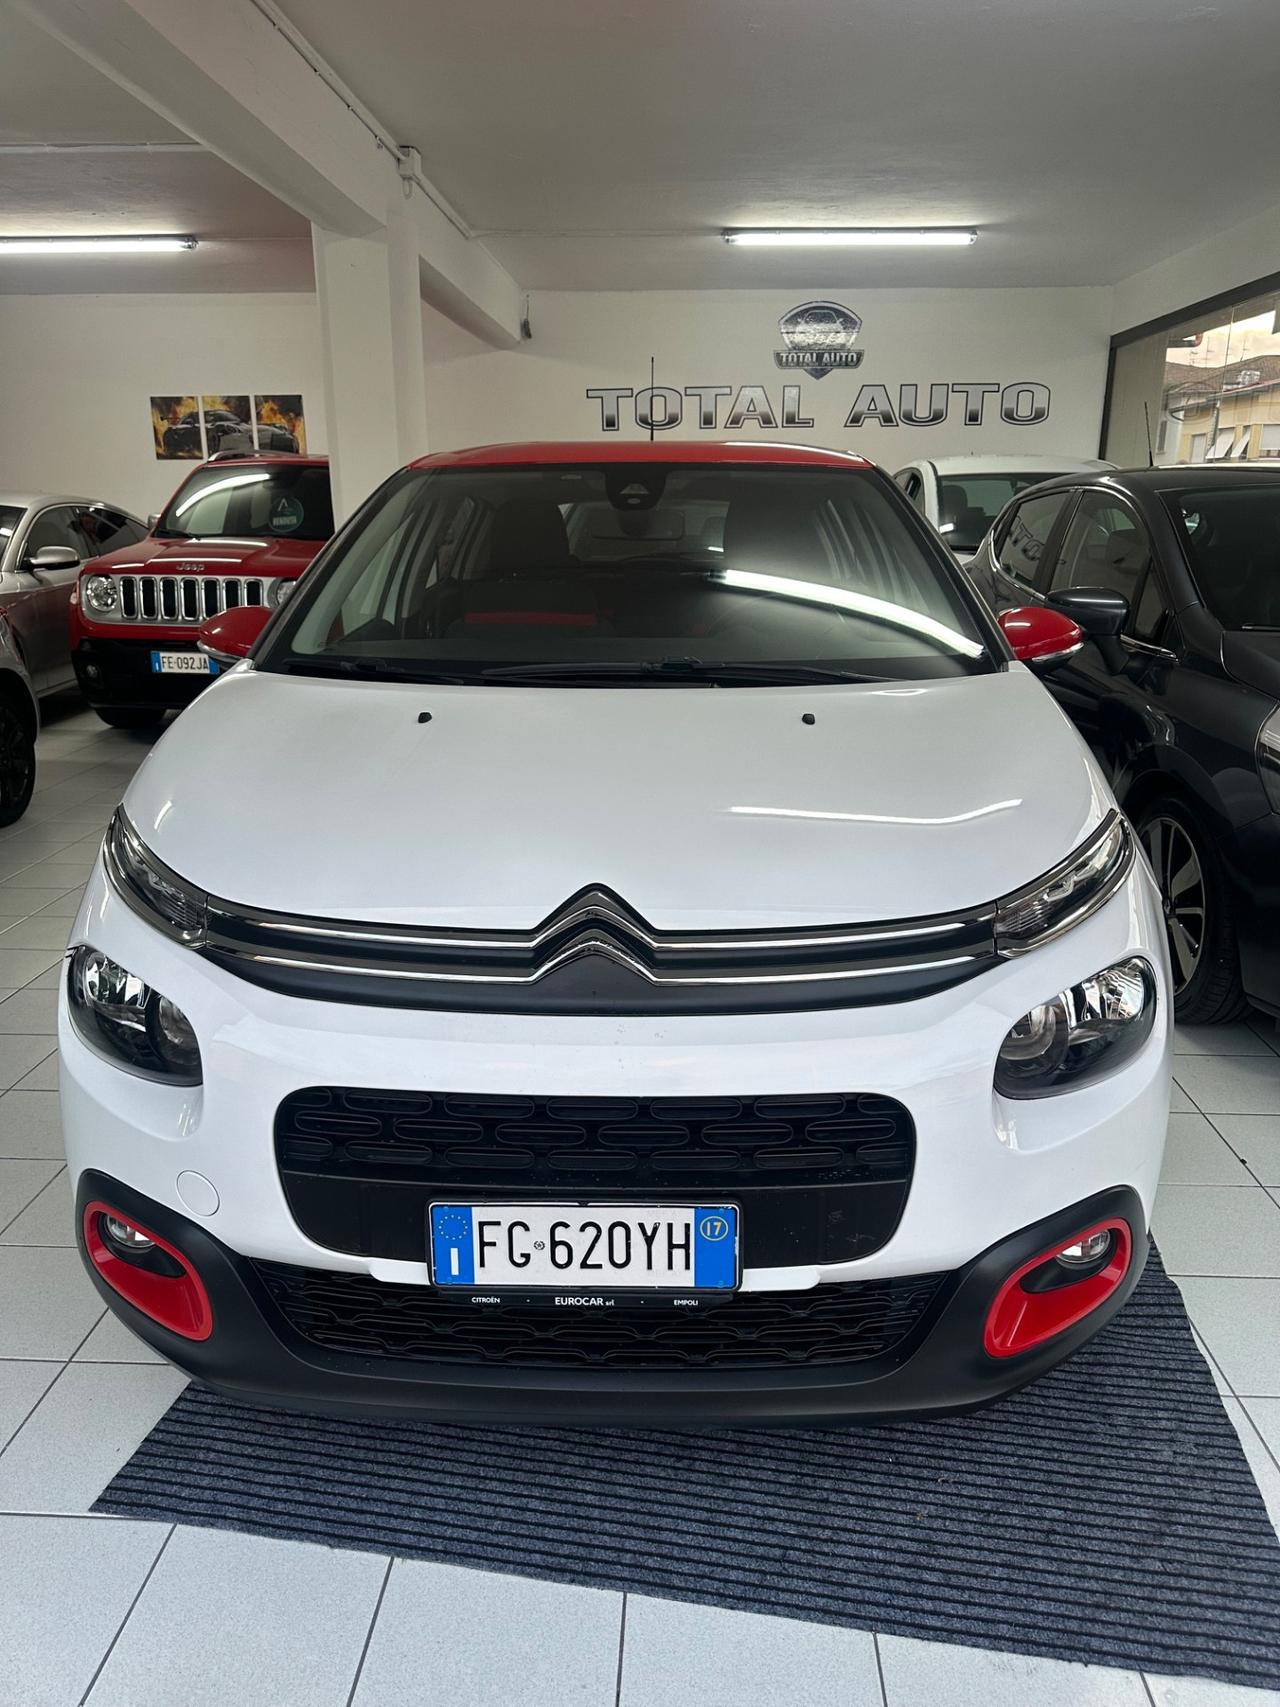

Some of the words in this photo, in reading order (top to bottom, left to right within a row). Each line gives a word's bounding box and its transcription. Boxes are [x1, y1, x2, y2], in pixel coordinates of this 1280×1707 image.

[780, 352, 817, 366] TOTAL
[822, 352, 857, 366] AUTO
[586, 385, 814, 432] TOTAL
[844, 382, 1051, 428] AUTO
[175, 562, 205, 573] Jeep
[706, 1221, 722, 1236] 17
[471, 1296, 501, 1304] CITROËN
[554, 1296, 604, 1306] EUROCAR
